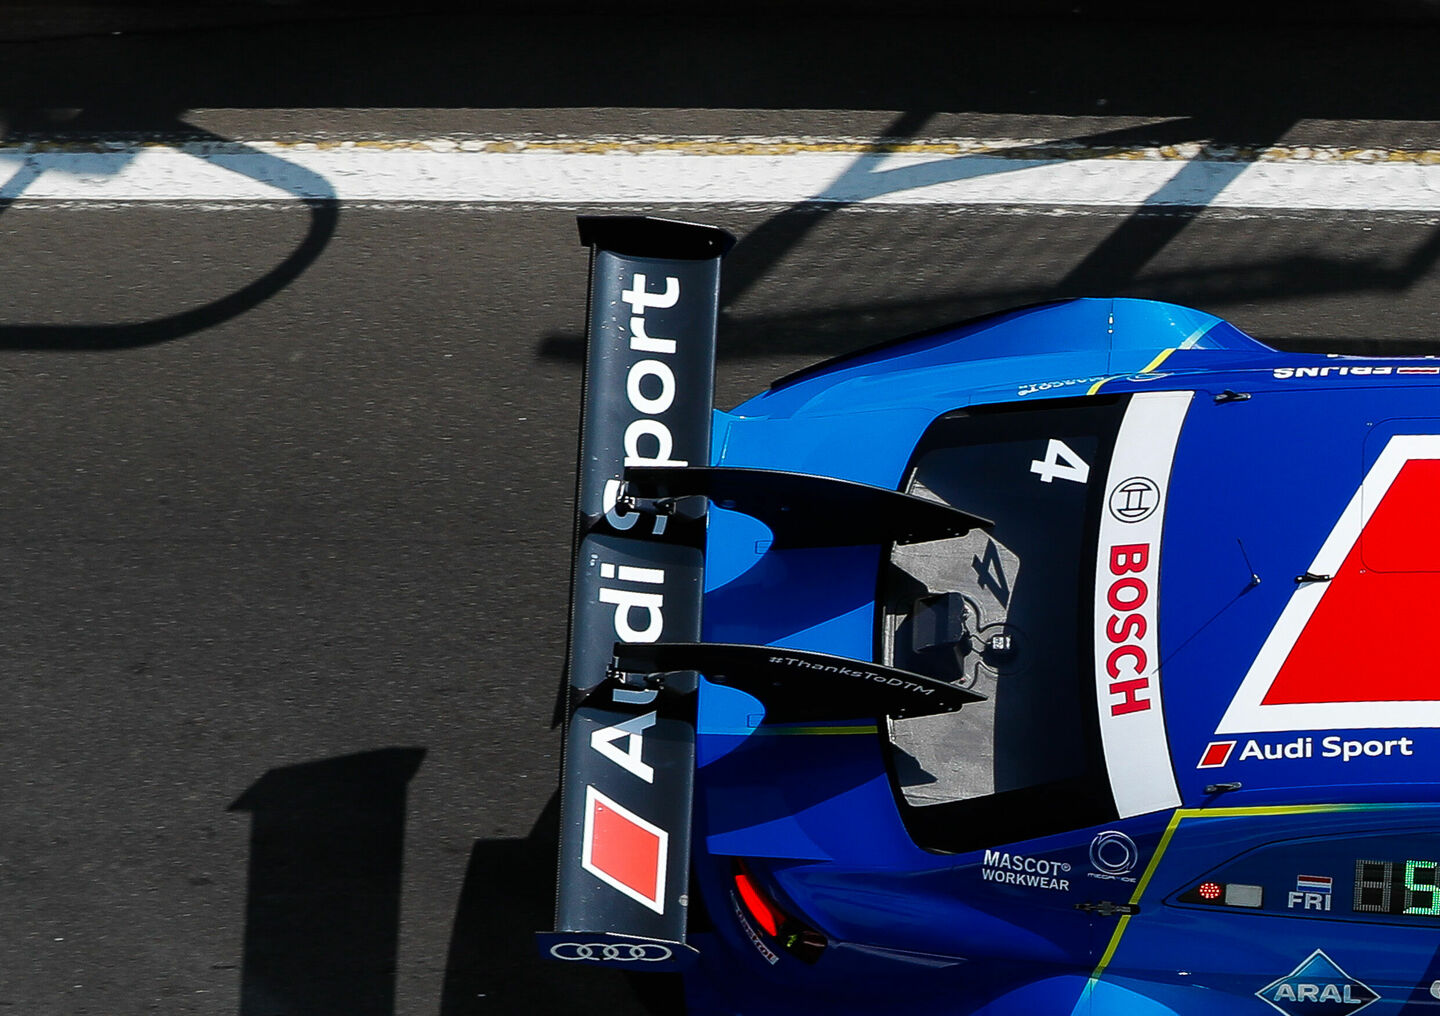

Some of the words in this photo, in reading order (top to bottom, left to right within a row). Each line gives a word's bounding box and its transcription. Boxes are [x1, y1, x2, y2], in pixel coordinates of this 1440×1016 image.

[1029, 438, 1091, 484] 4
[1106, 542, 1152, 717] BOSCH
[768, 656, 936, 696] #ThanksToDTM
[1238, 737, 1313, 762] Audi
[1322, 735, 1413, 763] Sport
[982, 868, 1069, 891] WORKWEAR
[1287, 891, 1332, 911] FRI
[1273, 982, 1362, 1004] ARAL
